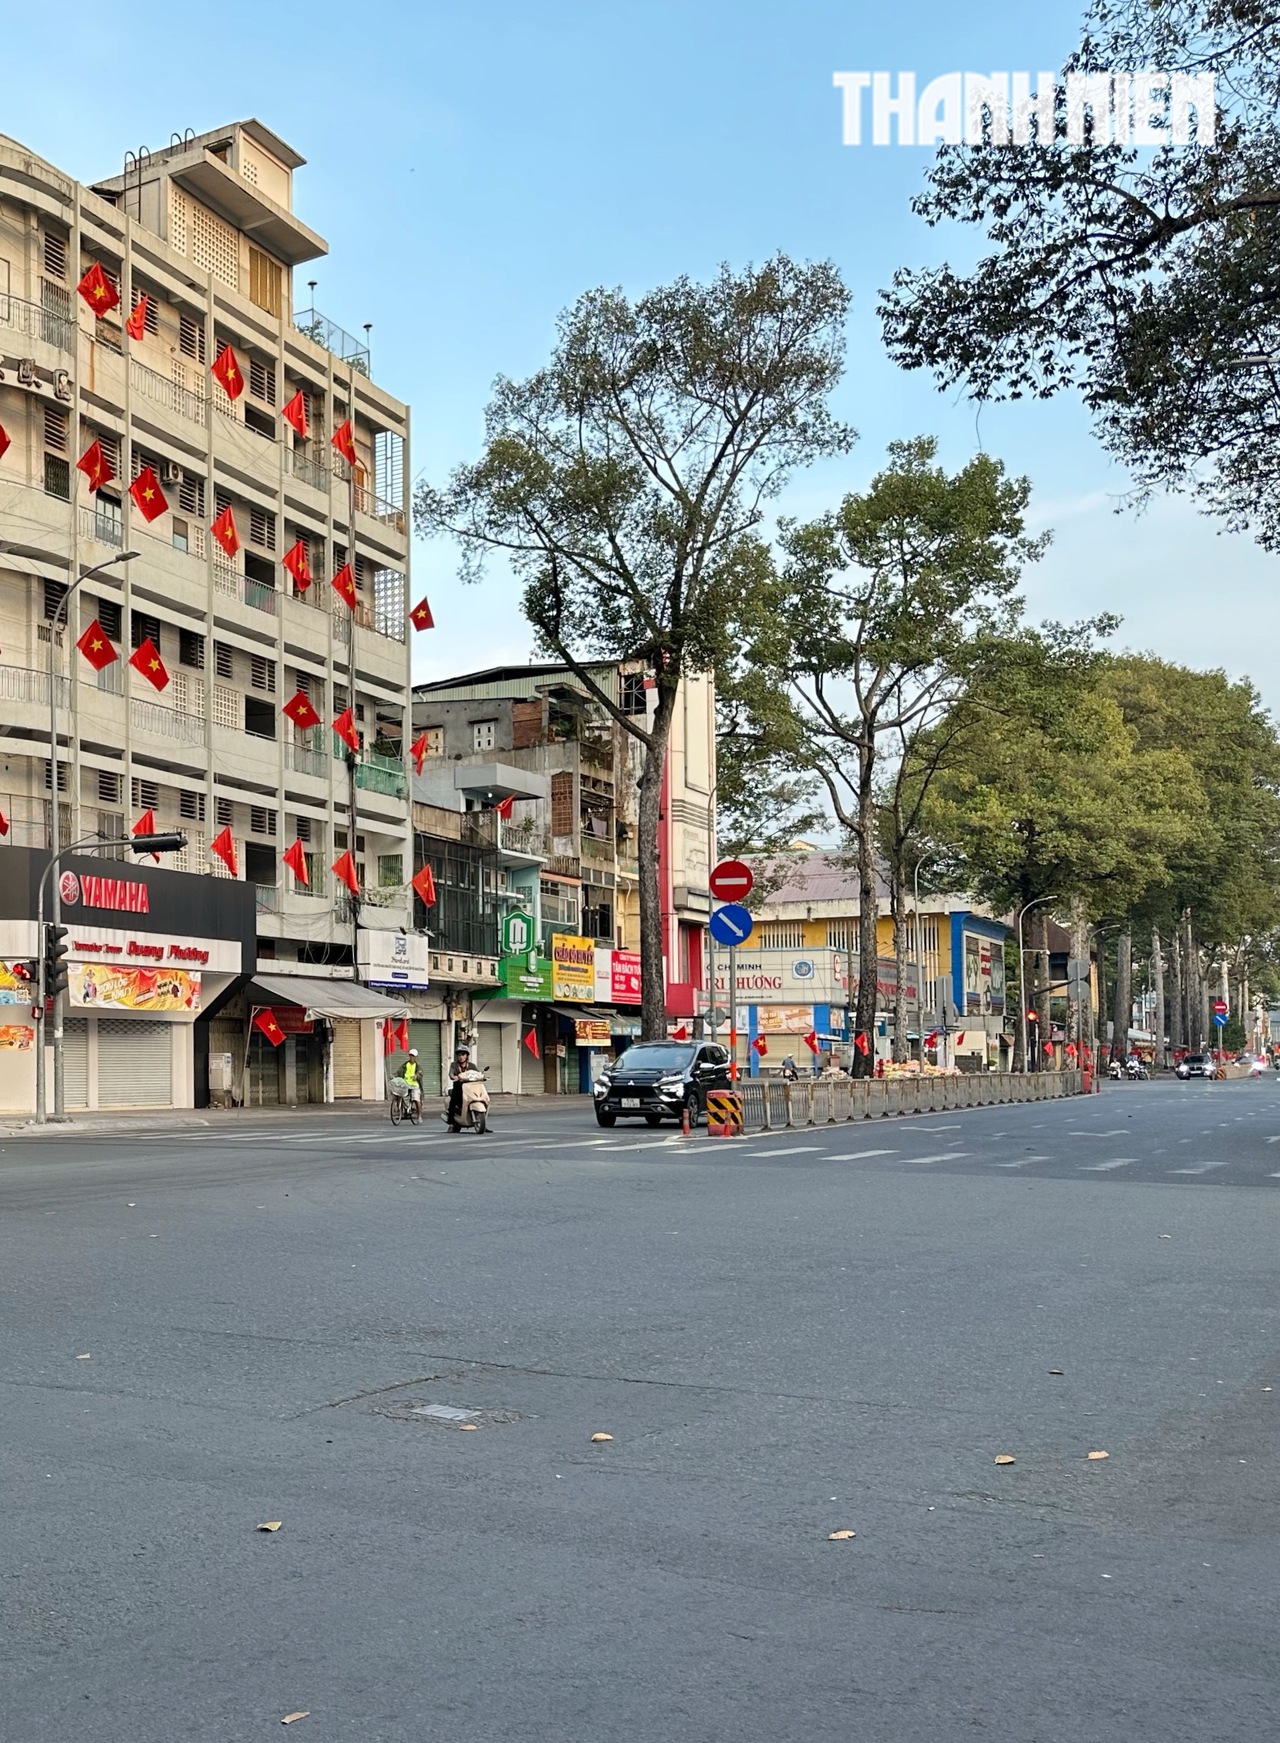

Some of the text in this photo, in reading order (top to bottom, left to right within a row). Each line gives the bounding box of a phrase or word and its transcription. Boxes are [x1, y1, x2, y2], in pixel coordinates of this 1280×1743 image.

[80, 875, 149, 913] YAMAHA
[126, 940, 164, 961] Quang
[729, 975, 782, 990] HƯƠNG
